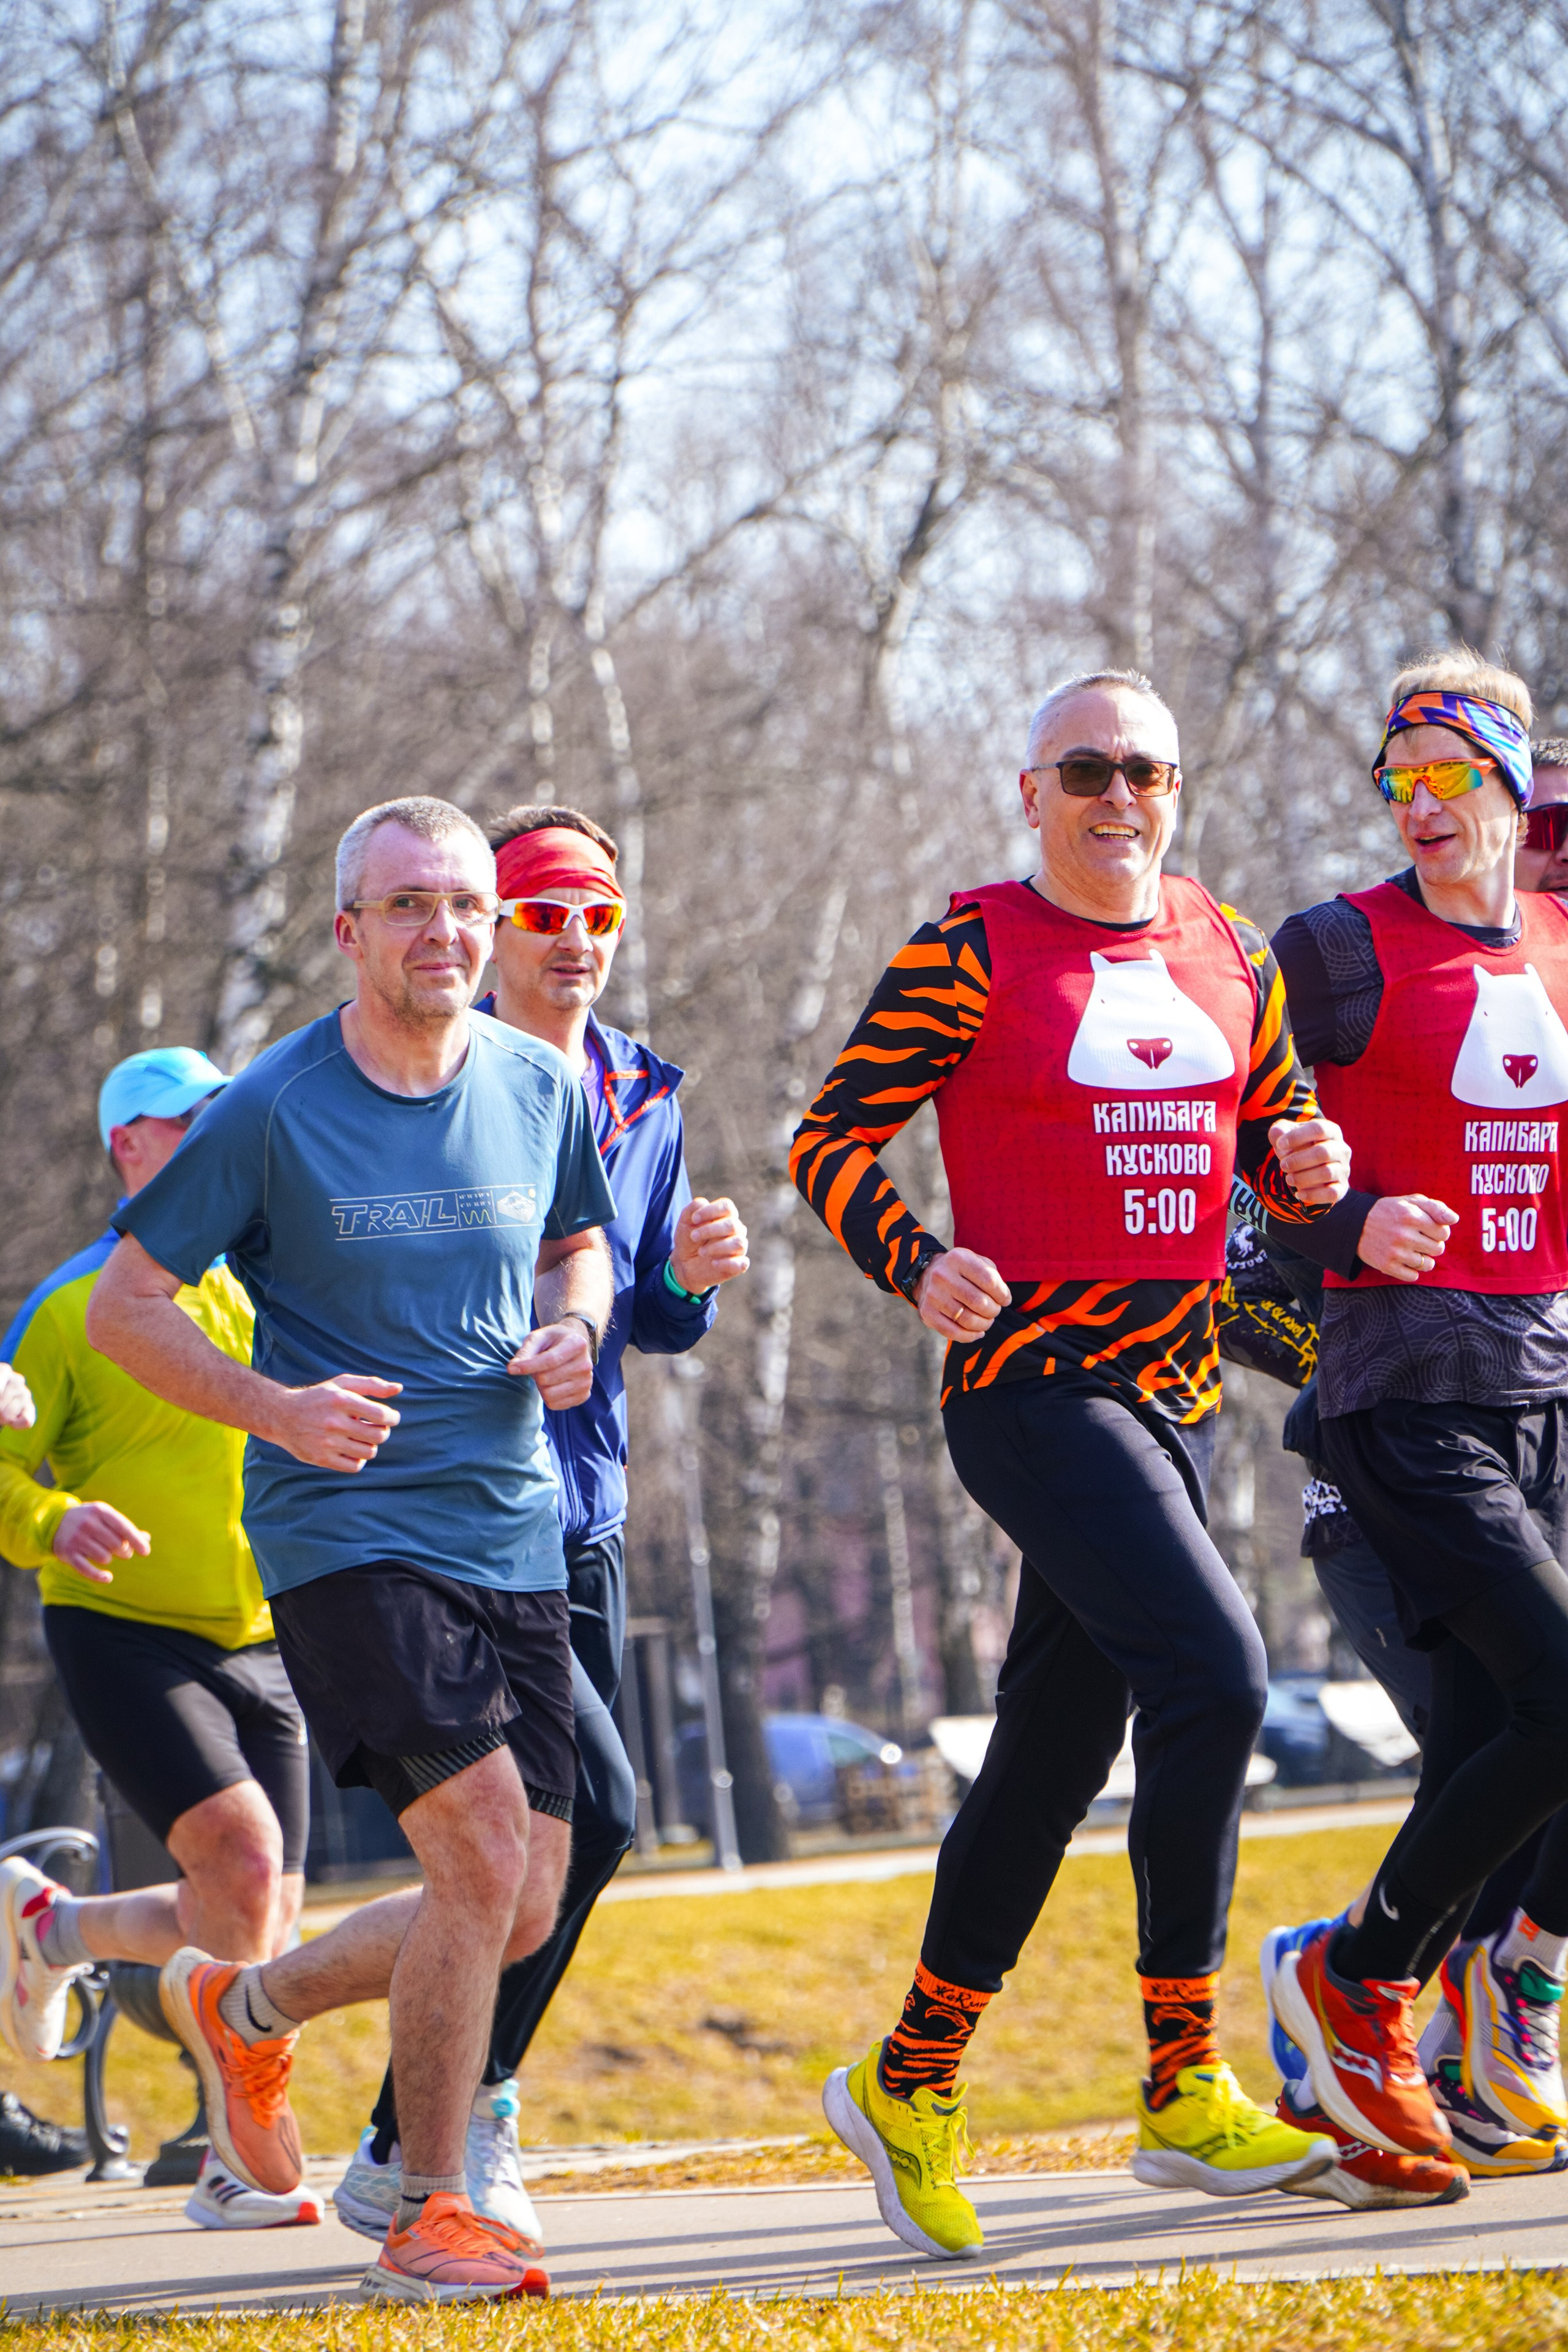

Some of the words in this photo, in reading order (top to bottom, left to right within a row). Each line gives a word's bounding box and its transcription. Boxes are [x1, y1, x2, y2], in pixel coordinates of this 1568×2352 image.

[1093, 1101, 1216, 1133] КАПИБАРА
[1464, 1121, 1559, 1152] КАПИБАРА
[1106, 1144, 1211, 1175] КУСКОВО
[1471, 1164, 1550, 1194] КУСКОВО
[331, 1198, 457, 1234] TRAIL
[1124, 1188, 1196, 1234] 5:00
[1482, 1207, 1537, 1252] 5:00
